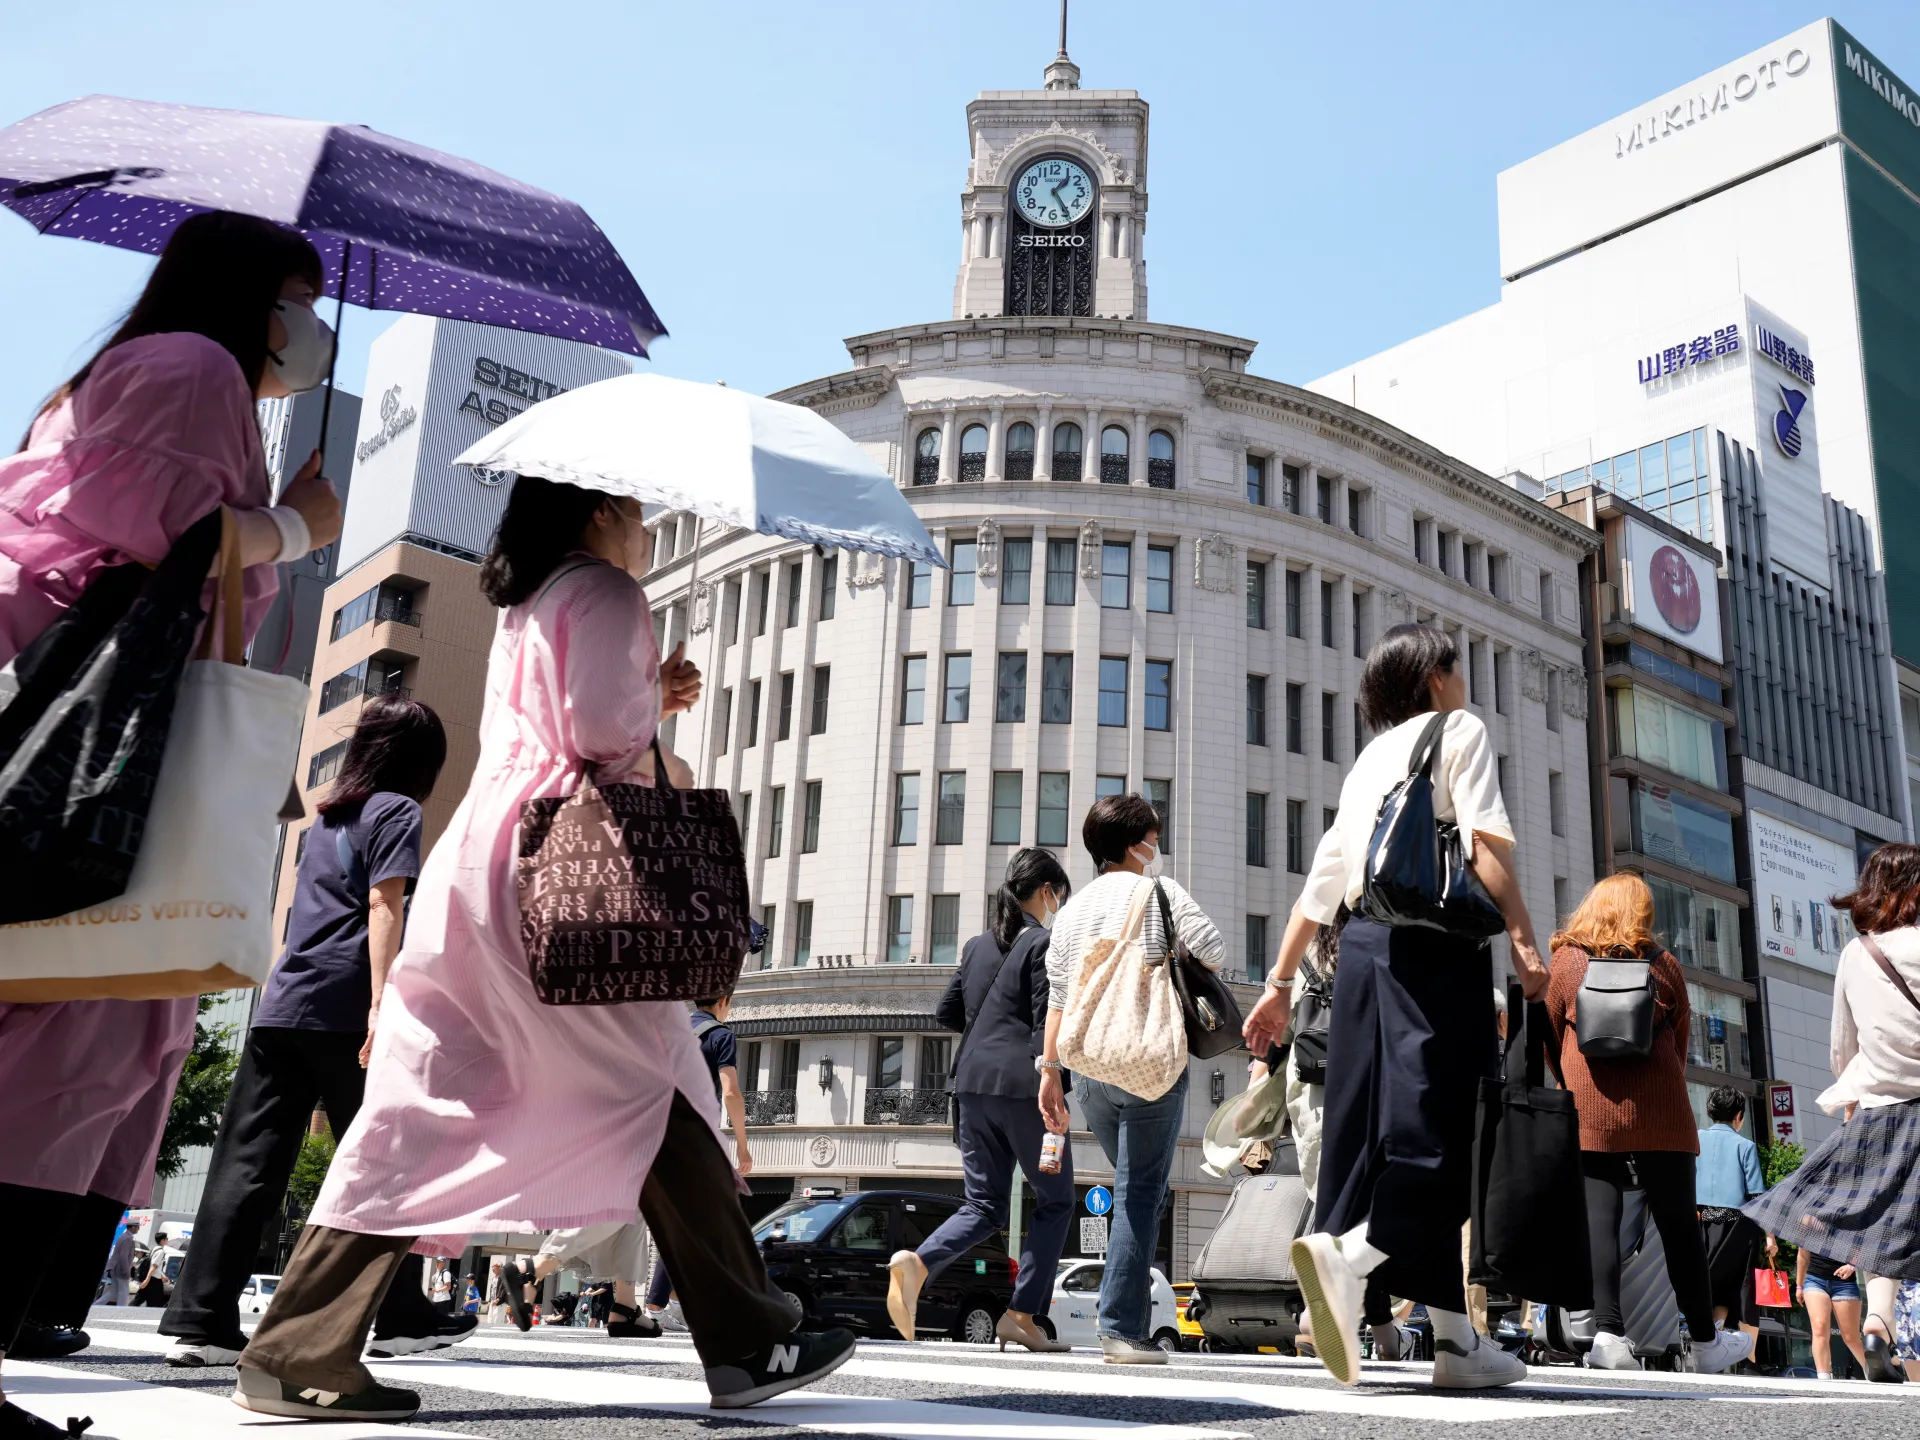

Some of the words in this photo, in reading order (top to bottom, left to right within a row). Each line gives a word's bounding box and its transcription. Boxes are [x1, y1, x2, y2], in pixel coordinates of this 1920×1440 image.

[1614, 47, 1810, 159] MIKIMOTO
[1038, 167, 1047, 177] 11
[1049, 164, 1061, 175] 12
[1027, 176, 1038, 186] 10
[1073, 175, 1082, 186] 2
[1023, 187, 1032, 198] 9
[1076, 187, 1085, 198] 3
[1027, 198, 1036, 209] 8
[1038, 206, 1046, 217] 7
[1071, 198, 1081, 209] 4
[1048, 209, 1057, 220] 6
[1019, 235, 1085, 247] SEIKO
[1638, 324, 1739, 384] 山野楽器
[1756, 324, 1816, 387] 山野楽器
[356, 424, 388, 461] Grand
[632, 831, 734, 857] PLAYERS
[552, 856, 664, 878] PLAYERS
[553, 871, 646, 888] PLAYERS
[79, 904, 142, 926] LOUIS
[151, 898, 248, 921] VUITTON
[690, 892, 711, 923] S
[608, 929, 633, 965] P
[639, 946, 730, 965] PLAYERS
[1766, 940, 1781, 953] KDDI
[1783, 946, 1796, 957] au
[576, 969, 669, 987] PLAYERS
[553, 981, 670, 1004] PLAYERS
[766, 1344, 800, 1373] N
